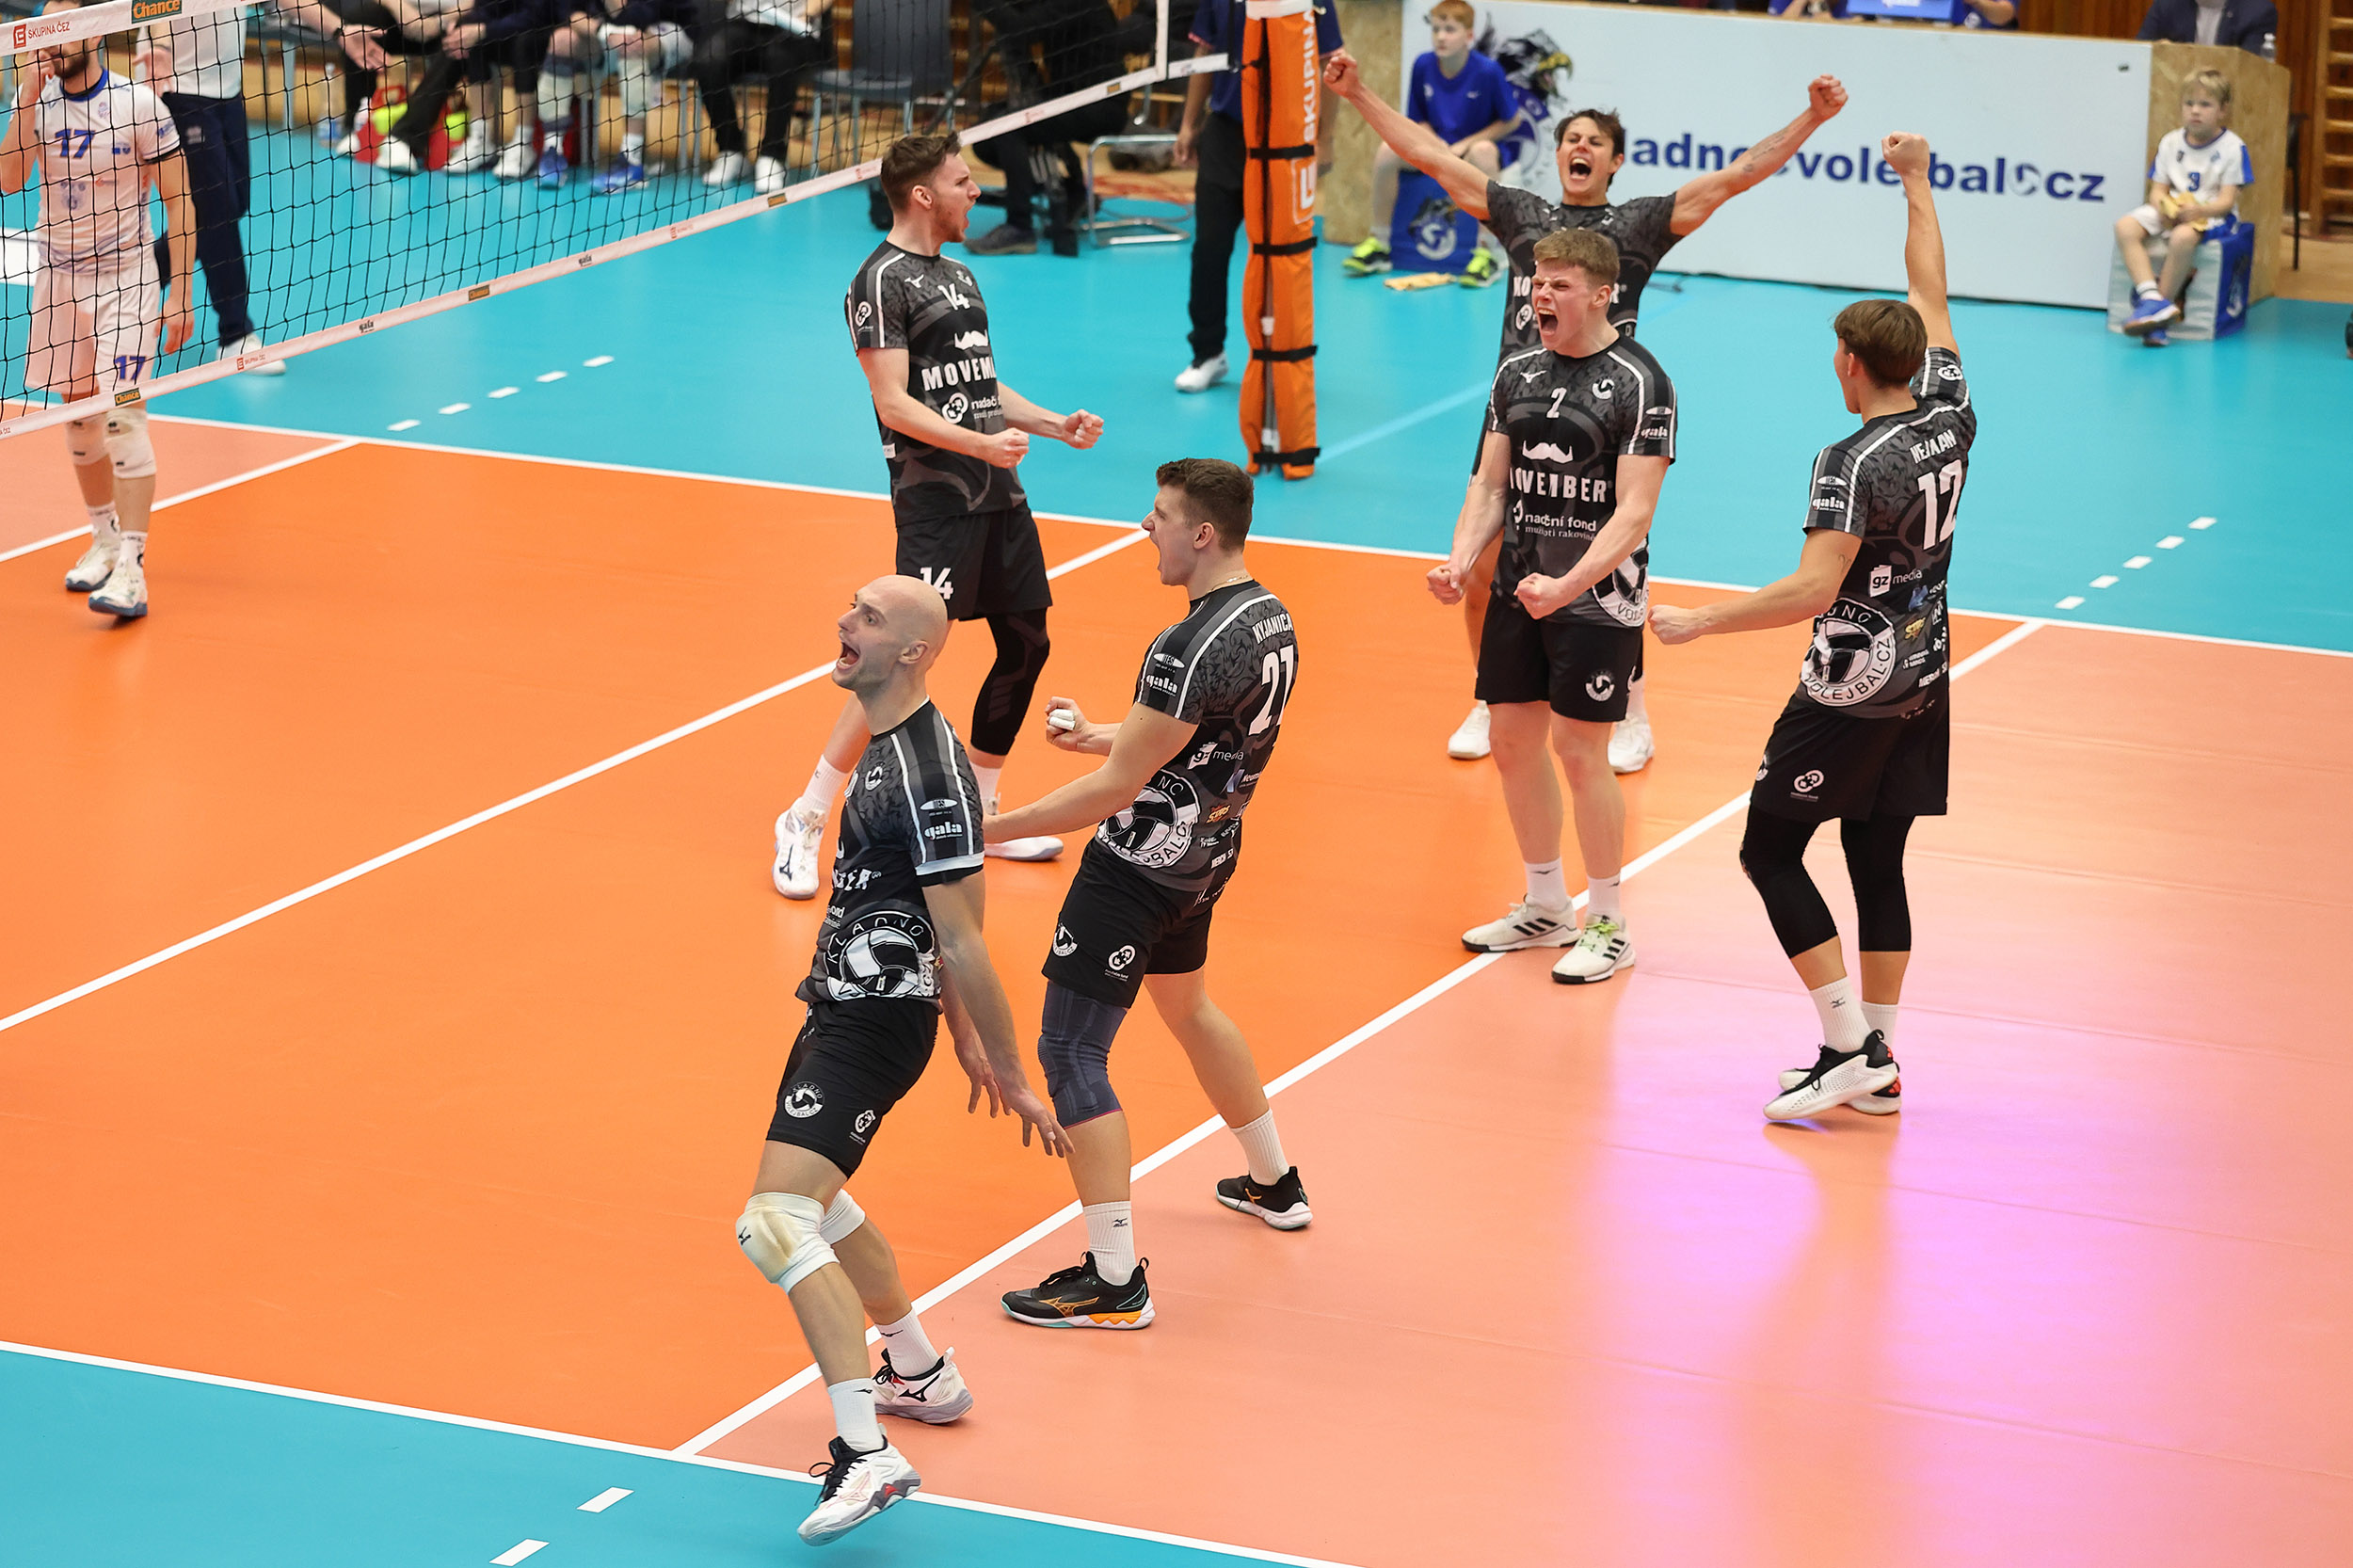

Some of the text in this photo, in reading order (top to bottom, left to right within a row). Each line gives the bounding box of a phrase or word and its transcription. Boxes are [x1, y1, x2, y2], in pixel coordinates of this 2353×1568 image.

[133, 0, 180, 19] Chance
[28, 22, 71, 39] SKUPINA ČEZ
[55, 128, 95, 158] 17
[937, 283, 970, 311] 14
[114, 356, 146, 380] 17
[1545, 387, 1567, 419] 2
[1812, 496, 1845, 511] gala
[1917, 458, 1962, 550] 12
[1567, 516, 1597, 532] fond
[920, 567, 953, 600] 14
[1873, 569, 1922, 588] gz media
[1145, 675, 1178, 694] gala
[1248, 644, 1294, 735] 21
[924, 821, 963, 840] gala
